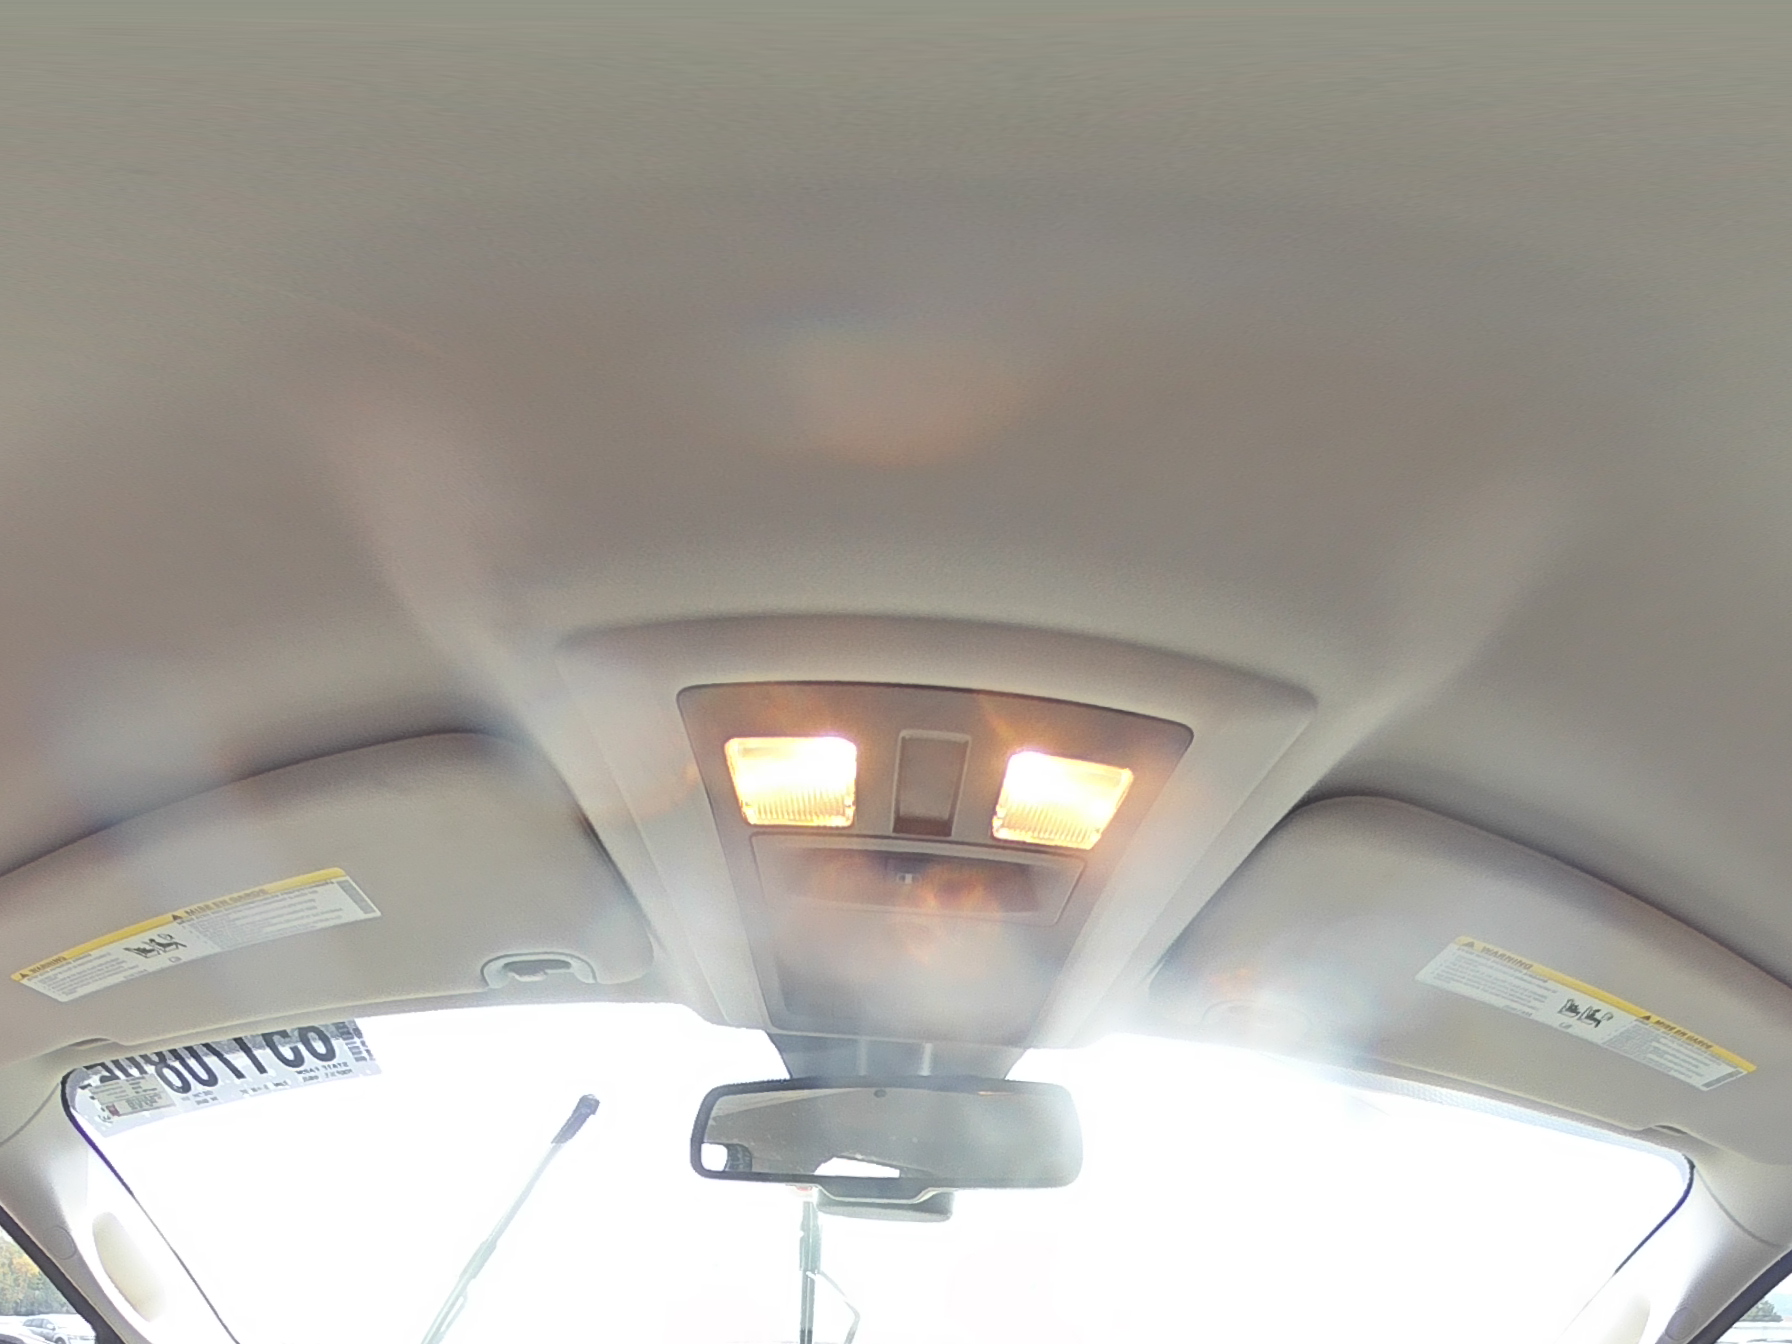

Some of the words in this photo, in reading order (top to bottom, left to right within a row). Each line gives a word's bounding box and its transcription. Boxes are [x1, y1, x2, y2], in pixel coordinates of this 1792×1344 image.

[184, 903, 210, 917] MISE
[27, 955, 68, 975] WARNING
[1480, 945, 1534, 971] WARNING
